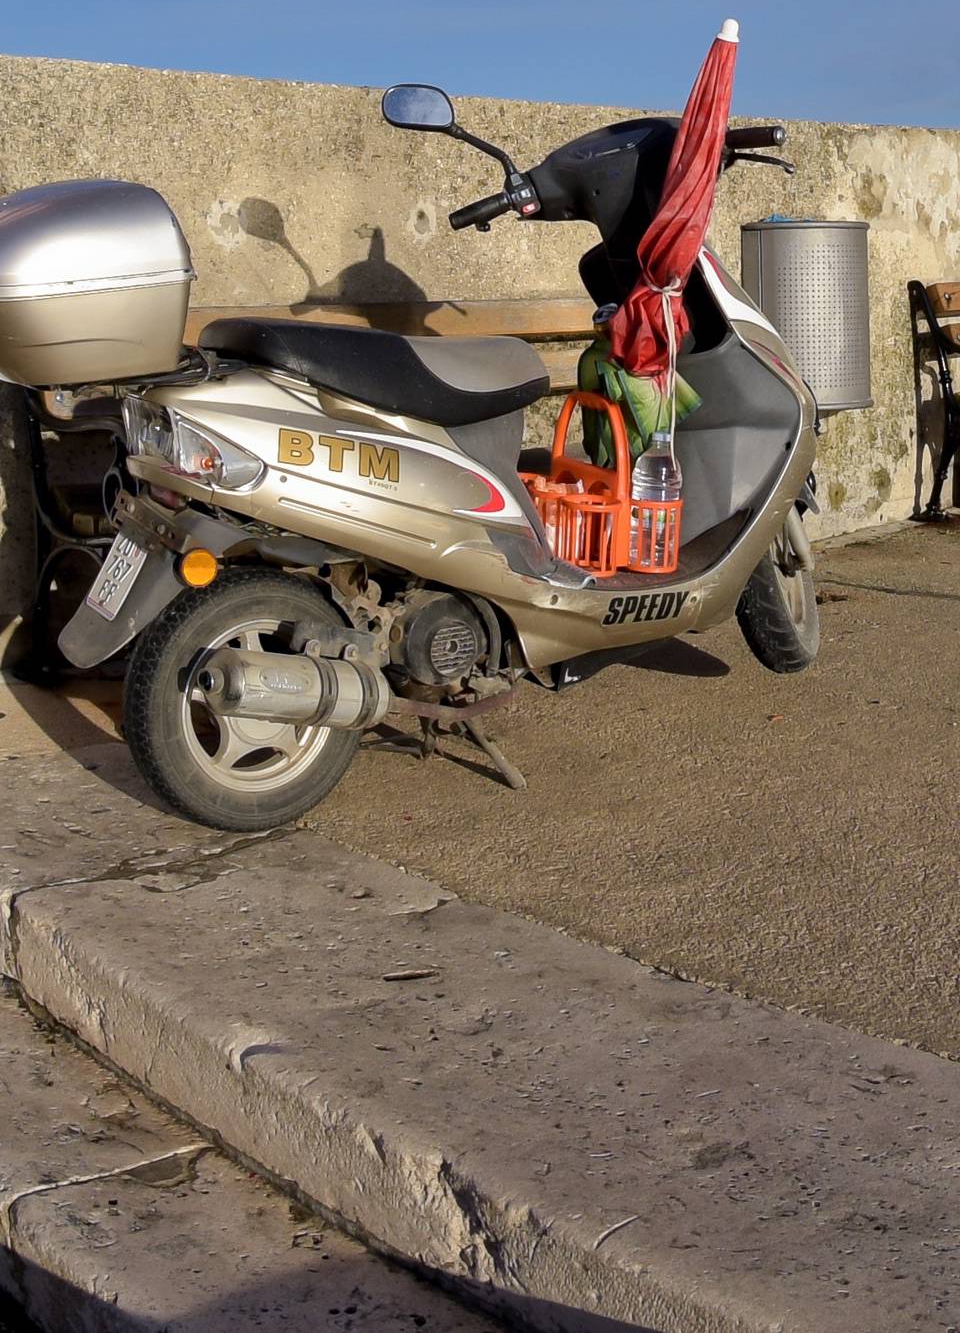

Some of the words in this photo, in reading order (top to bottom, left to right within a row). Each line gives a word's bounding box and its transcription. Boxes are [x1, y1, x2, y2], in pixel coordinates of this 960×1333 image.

[278, 428, 400, 483] BTM
[106, 555, 132, 581] 767
[602, 590, 689, 626] SPEEDY
